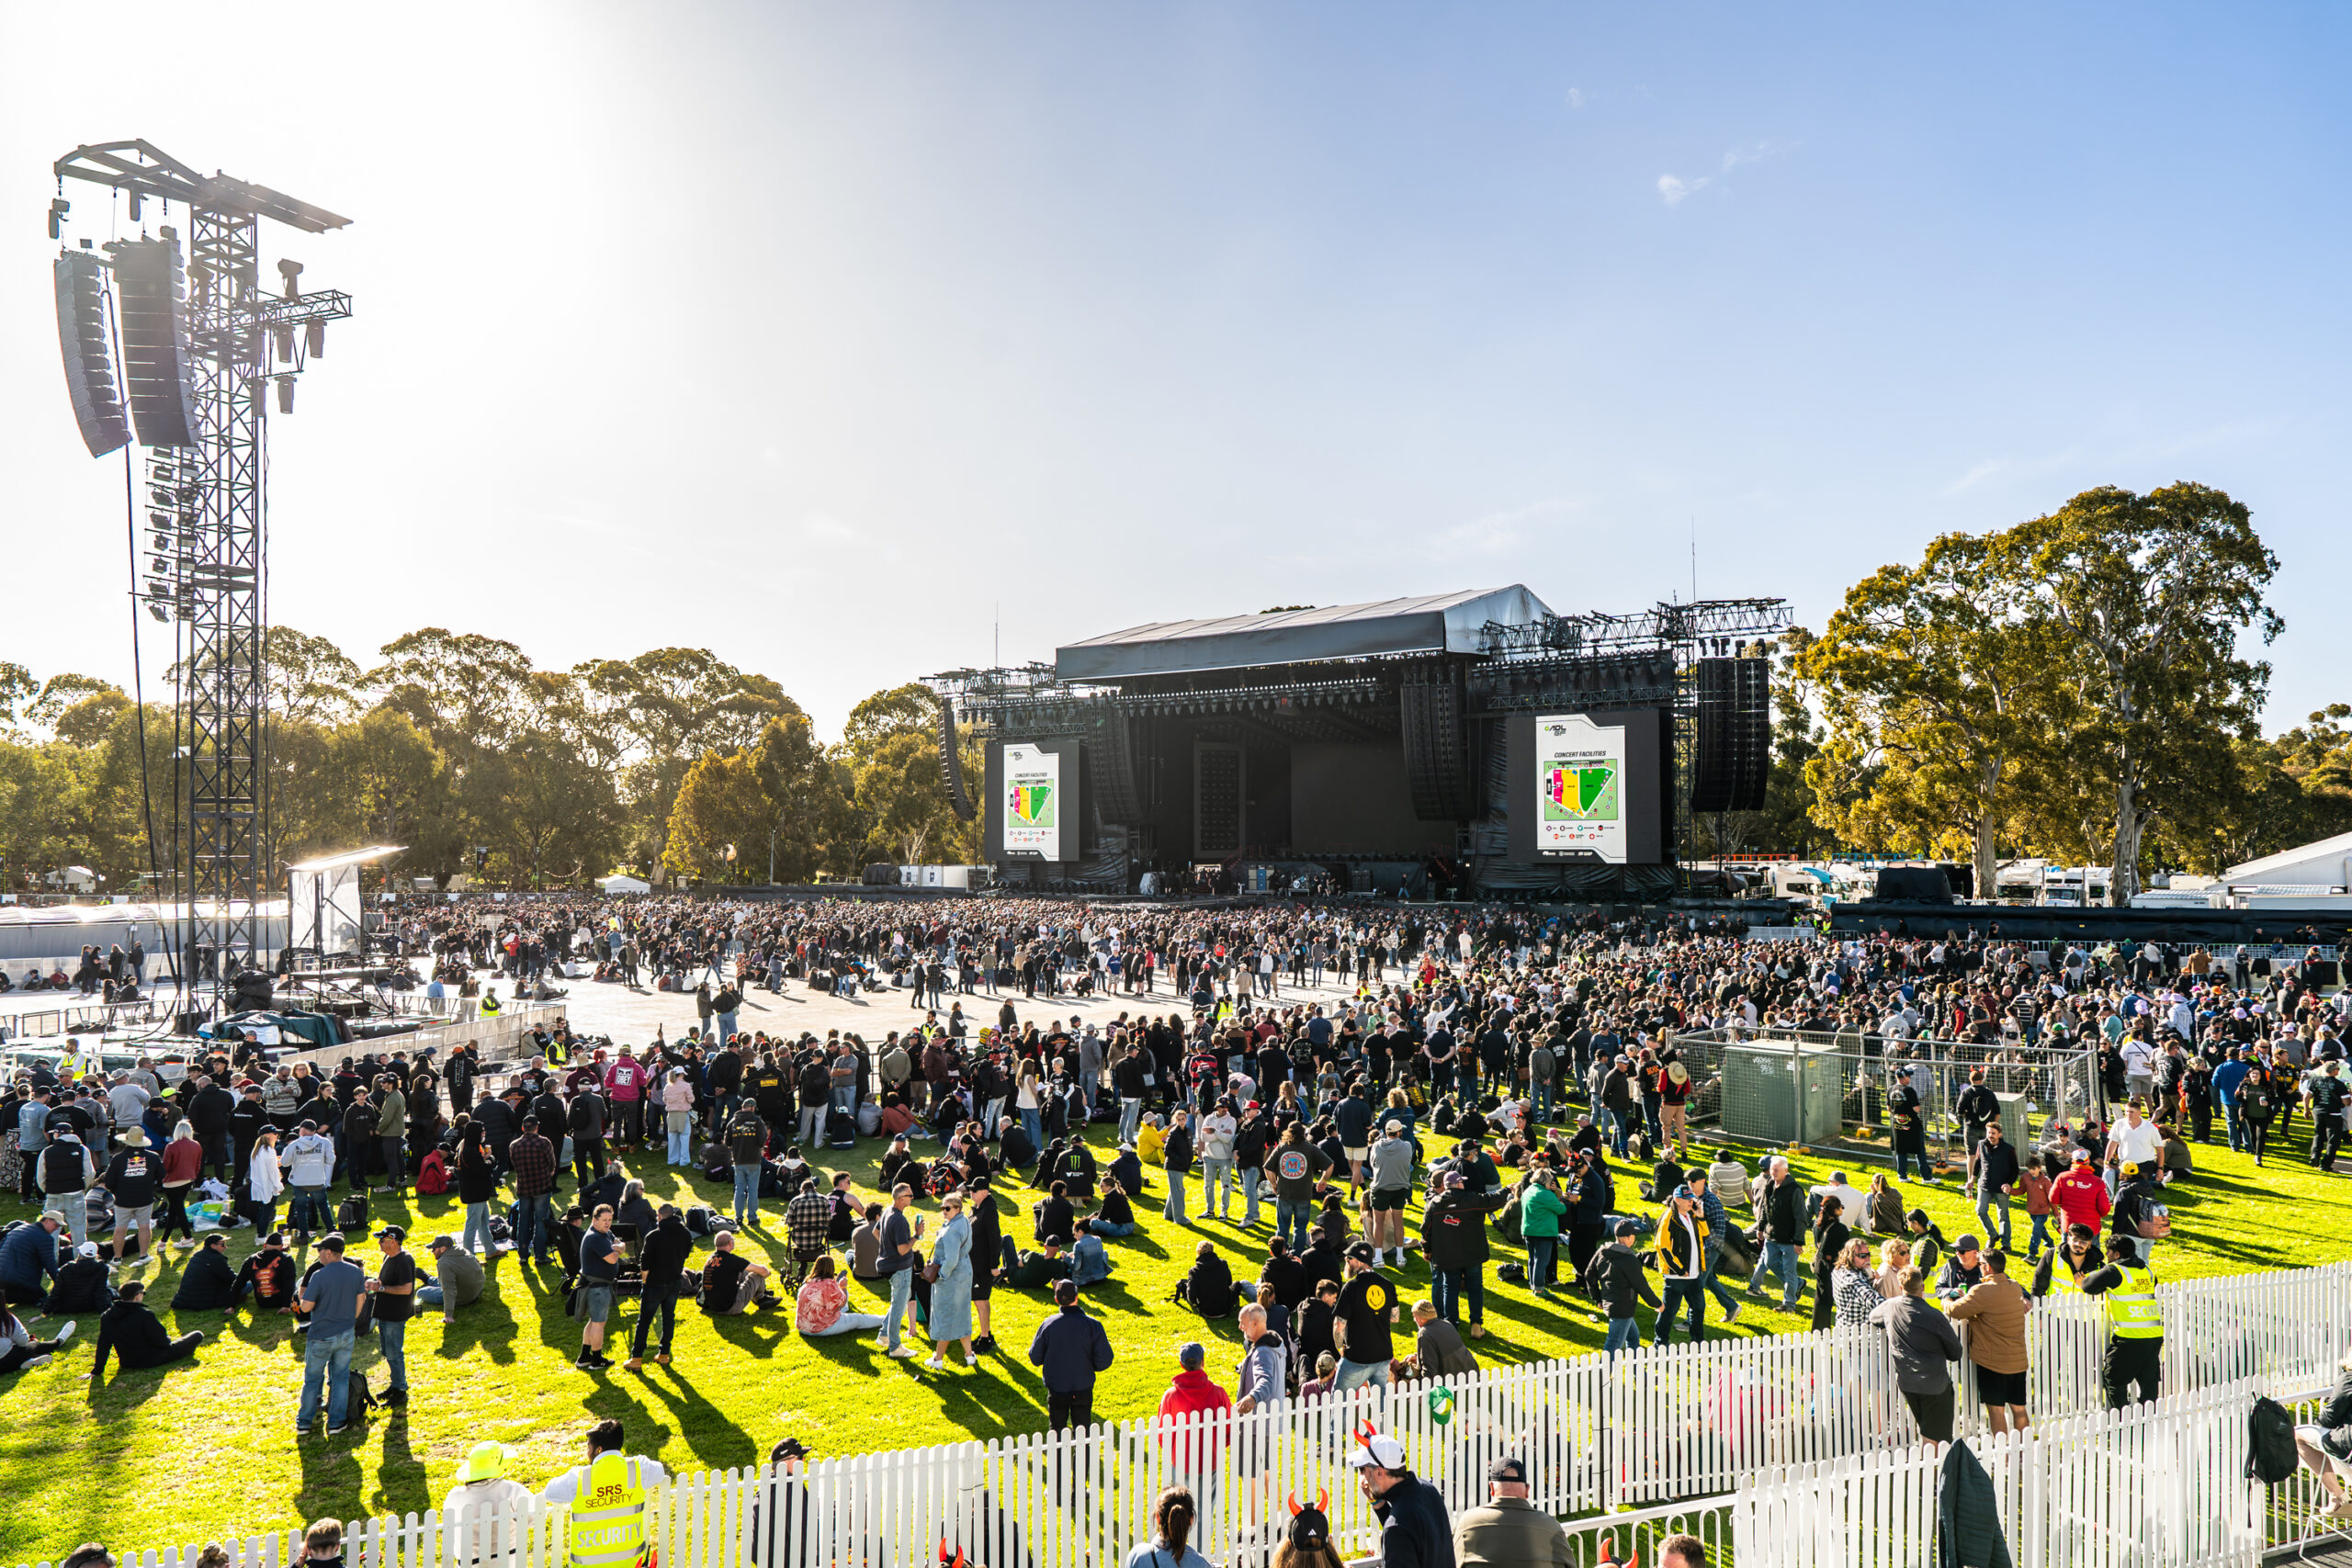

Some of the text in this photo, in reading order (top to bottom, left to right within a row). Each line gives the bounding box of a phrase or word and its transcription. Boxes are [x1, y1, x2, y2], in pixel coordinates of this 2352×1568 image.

[1579, 750, 1607, 758] FACILITIES
[1287, 1160, 1298, 1169] M
[2135, 1278, 2150, 1286] SRS
[596, 1483, 623, 1497] SRS
[585, 1493, 633, 1508] SECURITY
[577, 1520, 641, 1548] SECURITY
